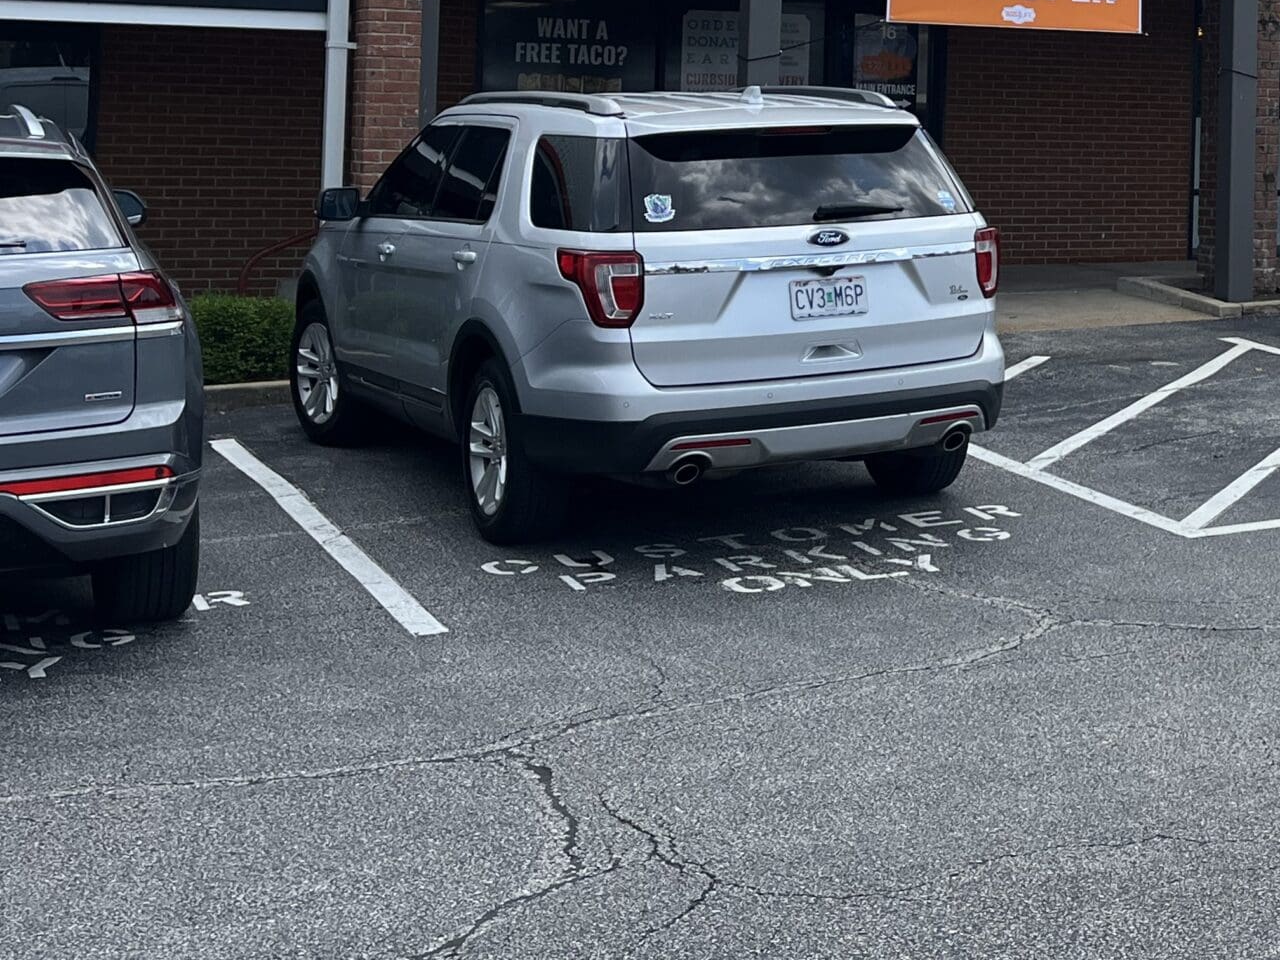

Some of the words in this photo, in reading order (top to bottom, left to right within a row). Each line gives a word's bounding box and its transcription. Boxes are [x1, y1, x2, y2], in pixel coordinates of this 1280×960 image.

[537, 16, 591, 40] WANT
[595, 20, 609, 41] A
[687, 19, 736, 32] ORDE
[687, 36, 738, 49] DONAT
[515, 42, 562, 64] FREE
[567, 43, 628, 66] TACO?
[686, 53, 730, 65] EAR
[686, 72, 736, 86] CURBSID
[817, 231, 841, 244] Ford
[795, 287, 826, 310] CV3
[834, 284, 864, 307] M6P
[481, 504, 1022, 575] CUSTOMER
[558, 526, 1011, 591] PARKING
